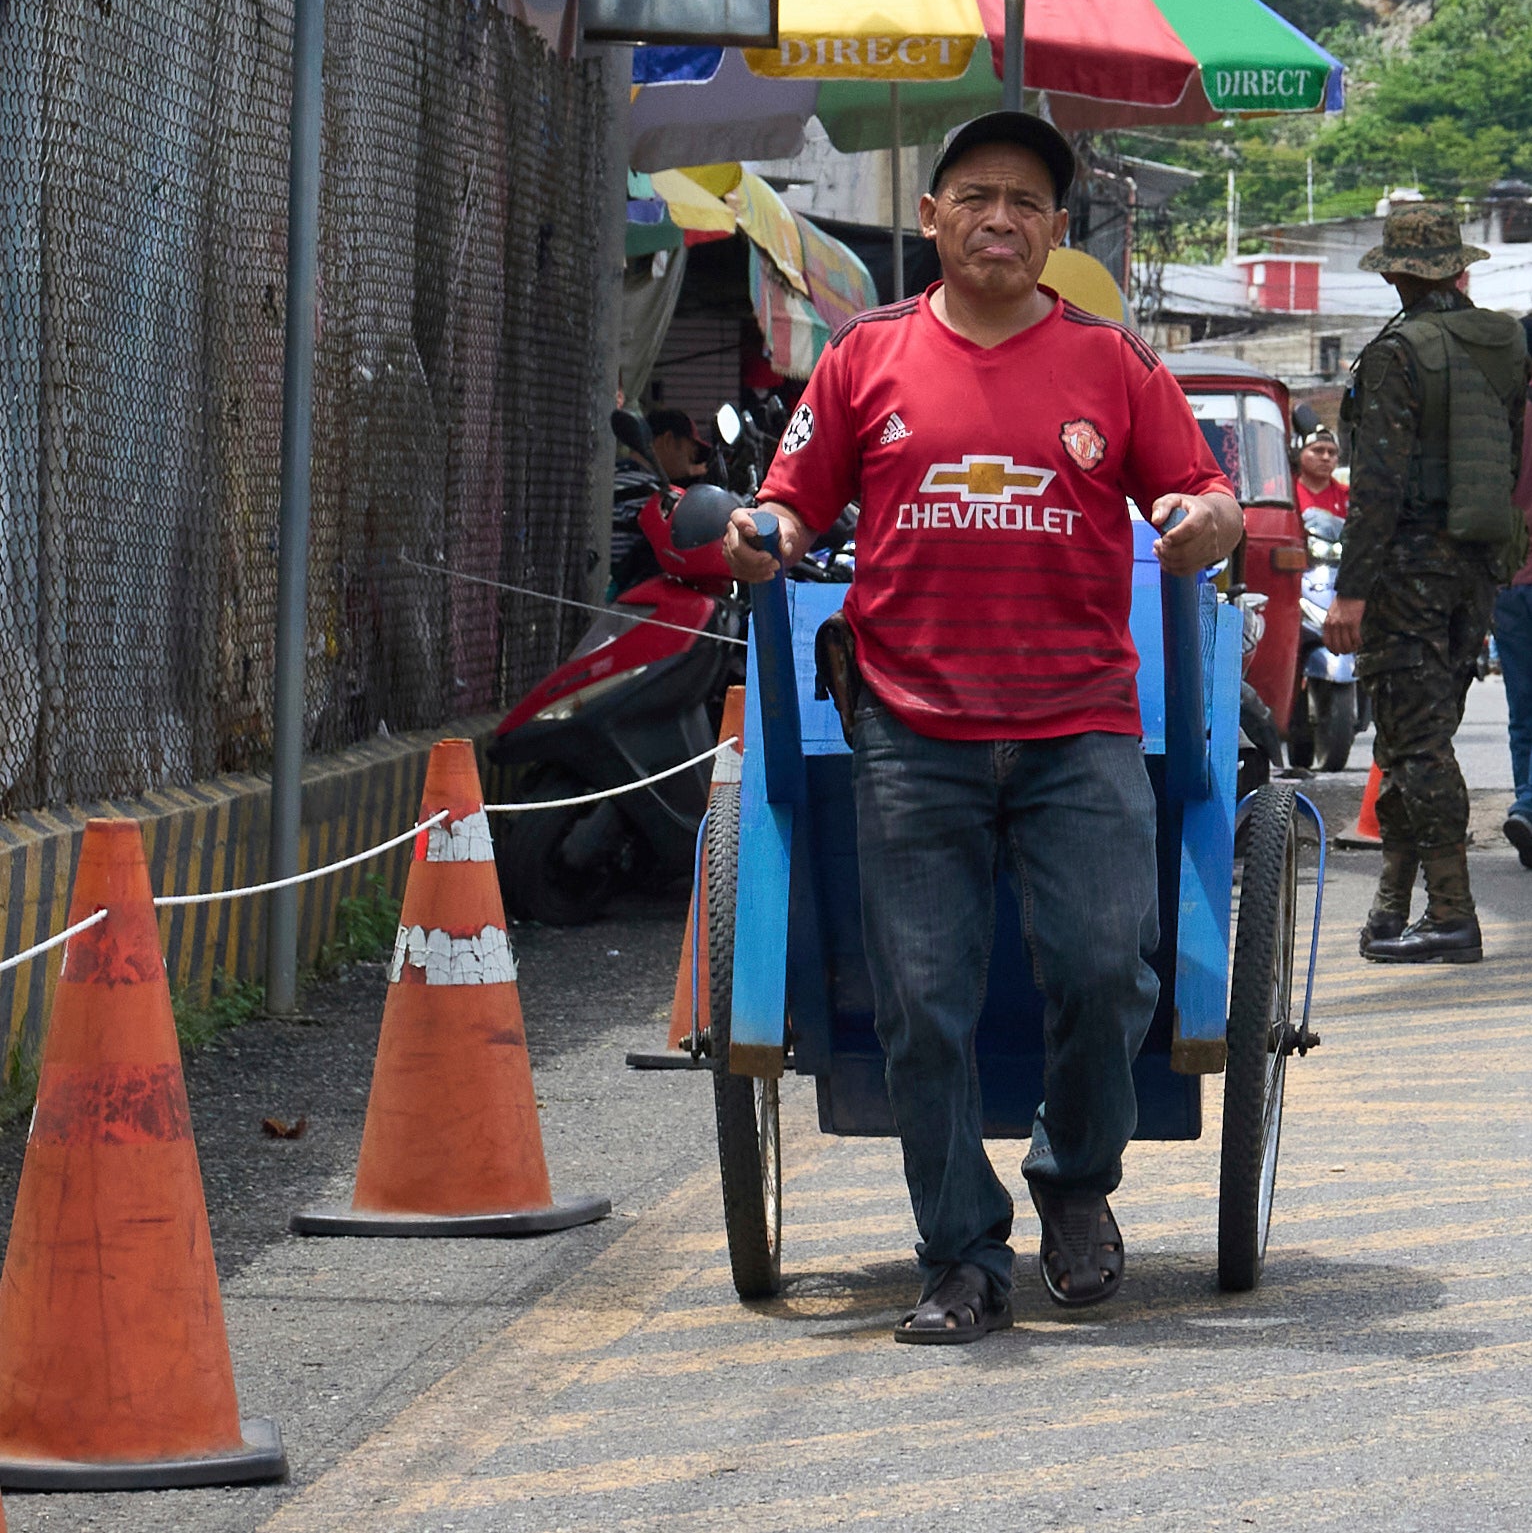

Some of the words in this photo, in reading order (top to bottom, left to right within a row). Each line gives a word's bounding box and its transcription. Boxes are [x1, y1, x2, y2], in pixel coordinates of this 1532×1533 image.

[778, 37, 962, 67] DIRECT
[1215, 68, 1312, 98] DIRECT
[895, 502, 1082, 535] CHEVROLET
